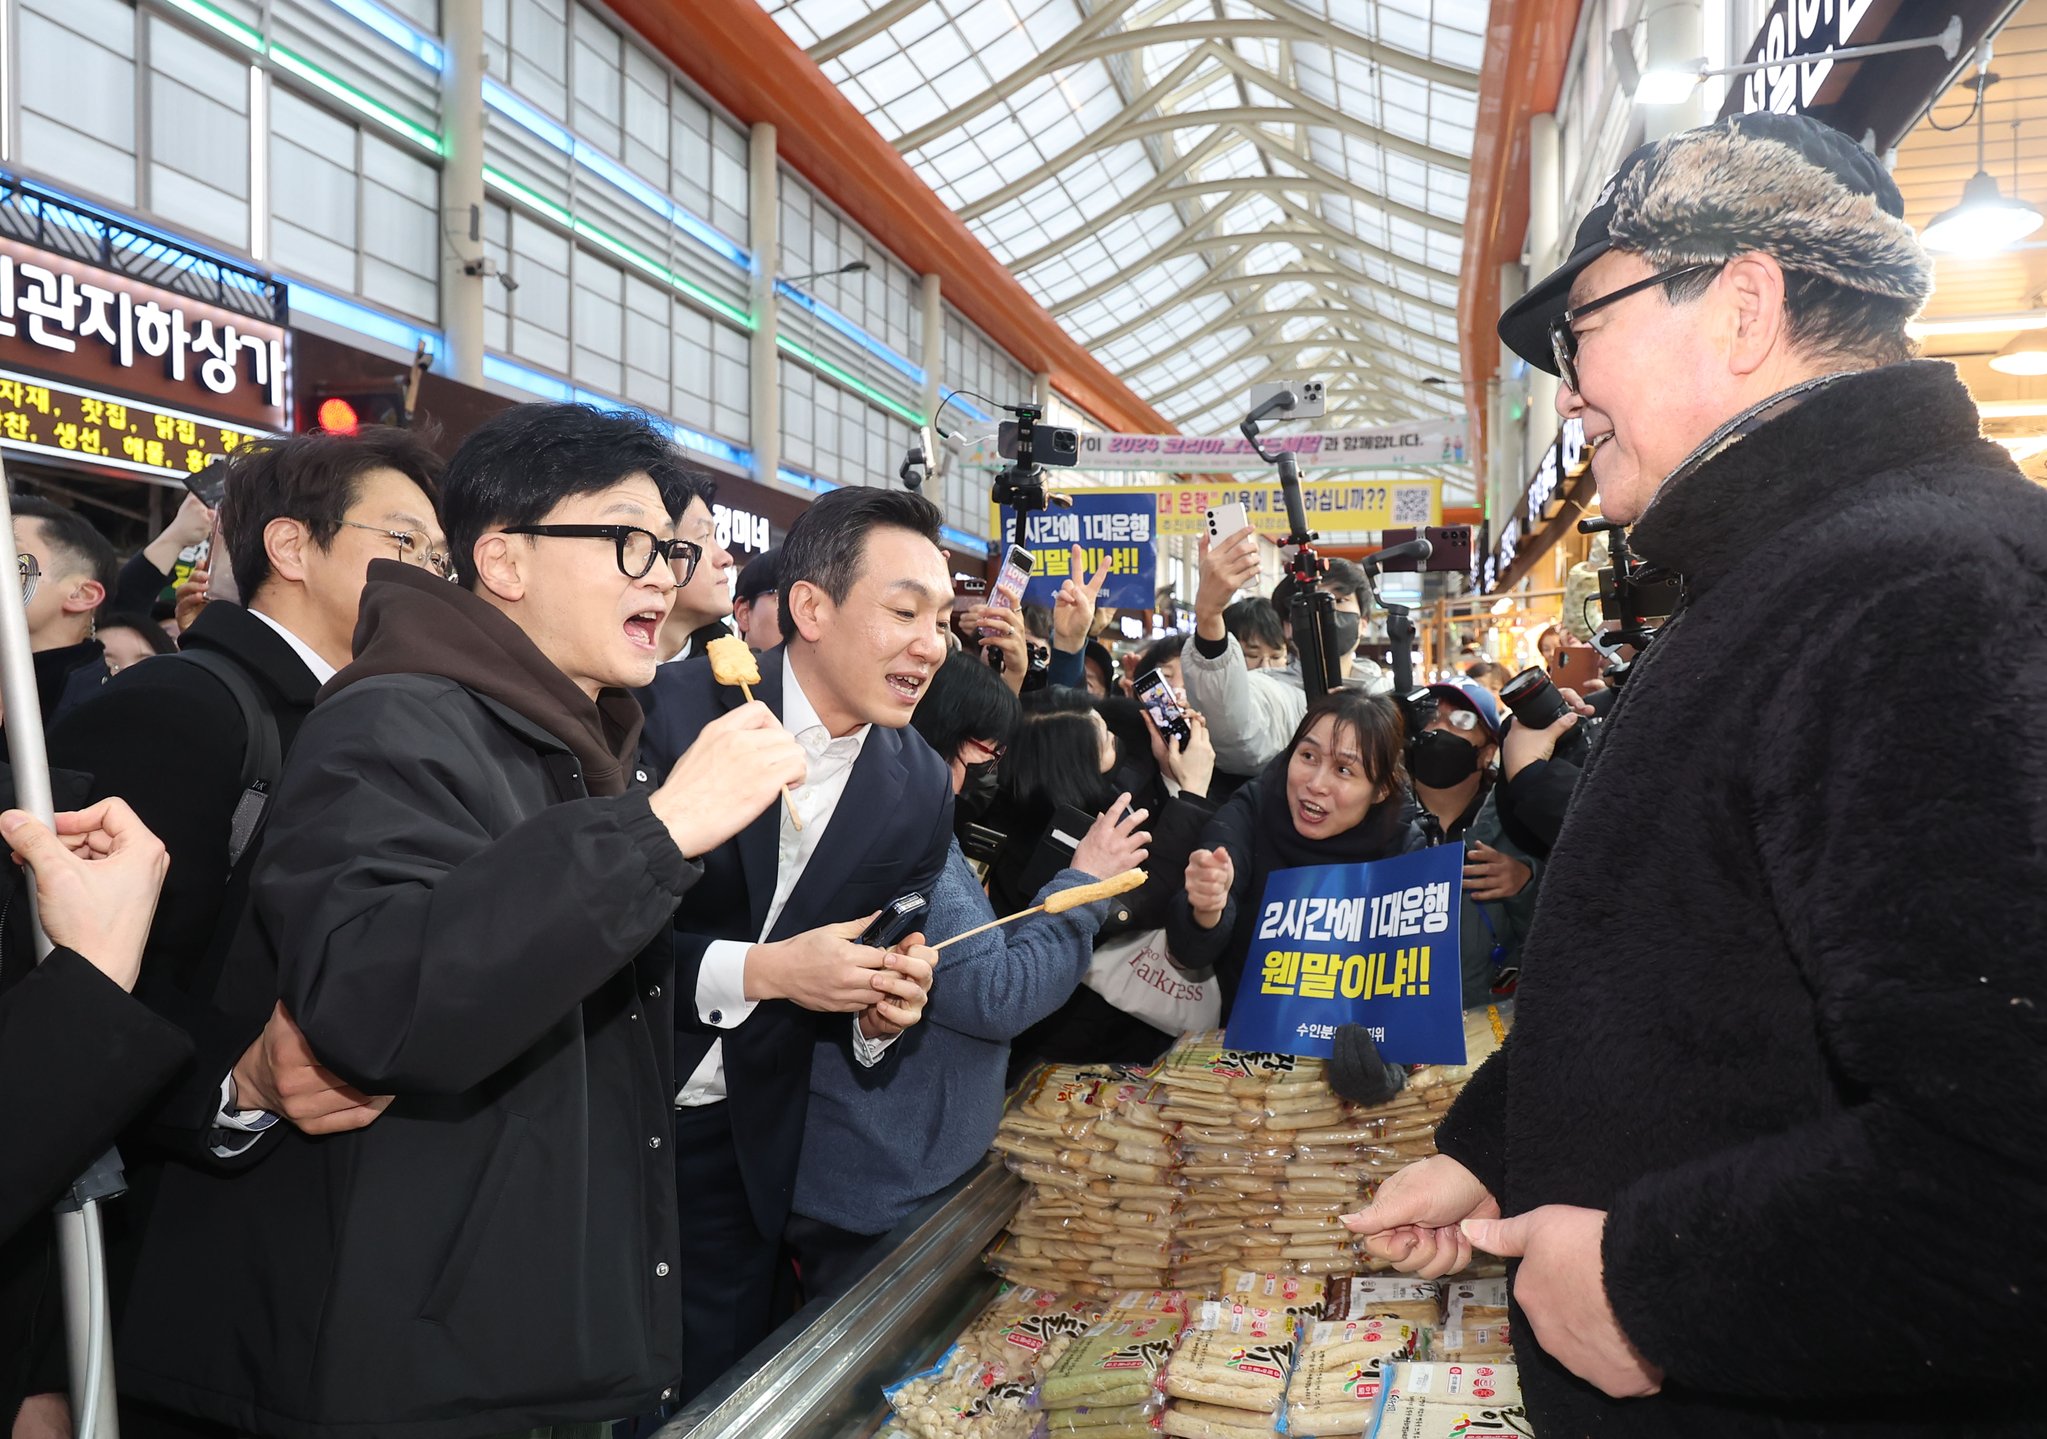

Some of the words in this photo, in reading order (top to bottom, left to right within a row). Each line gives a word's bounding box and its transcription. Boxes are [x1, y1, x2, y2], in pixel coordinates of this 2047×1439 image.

[0, 254, 286, 407] 관지하상가
[0, 410, 38, 443] 찬,
[53, 422, 109, 456] 생선,
[122, 436, 172, 469] 해물,
[1108, 436, 1160, 453] 2024
[1083, 513, 1150, 543] 1대운행
[1006, 567, 1028, 585] LOVE
[1258, 897, 1365, 942] 2시간에
[1369, 881, 1450, 938] 1대운행
[1260, 946, 1431, 1000] 웬말이냐!!
